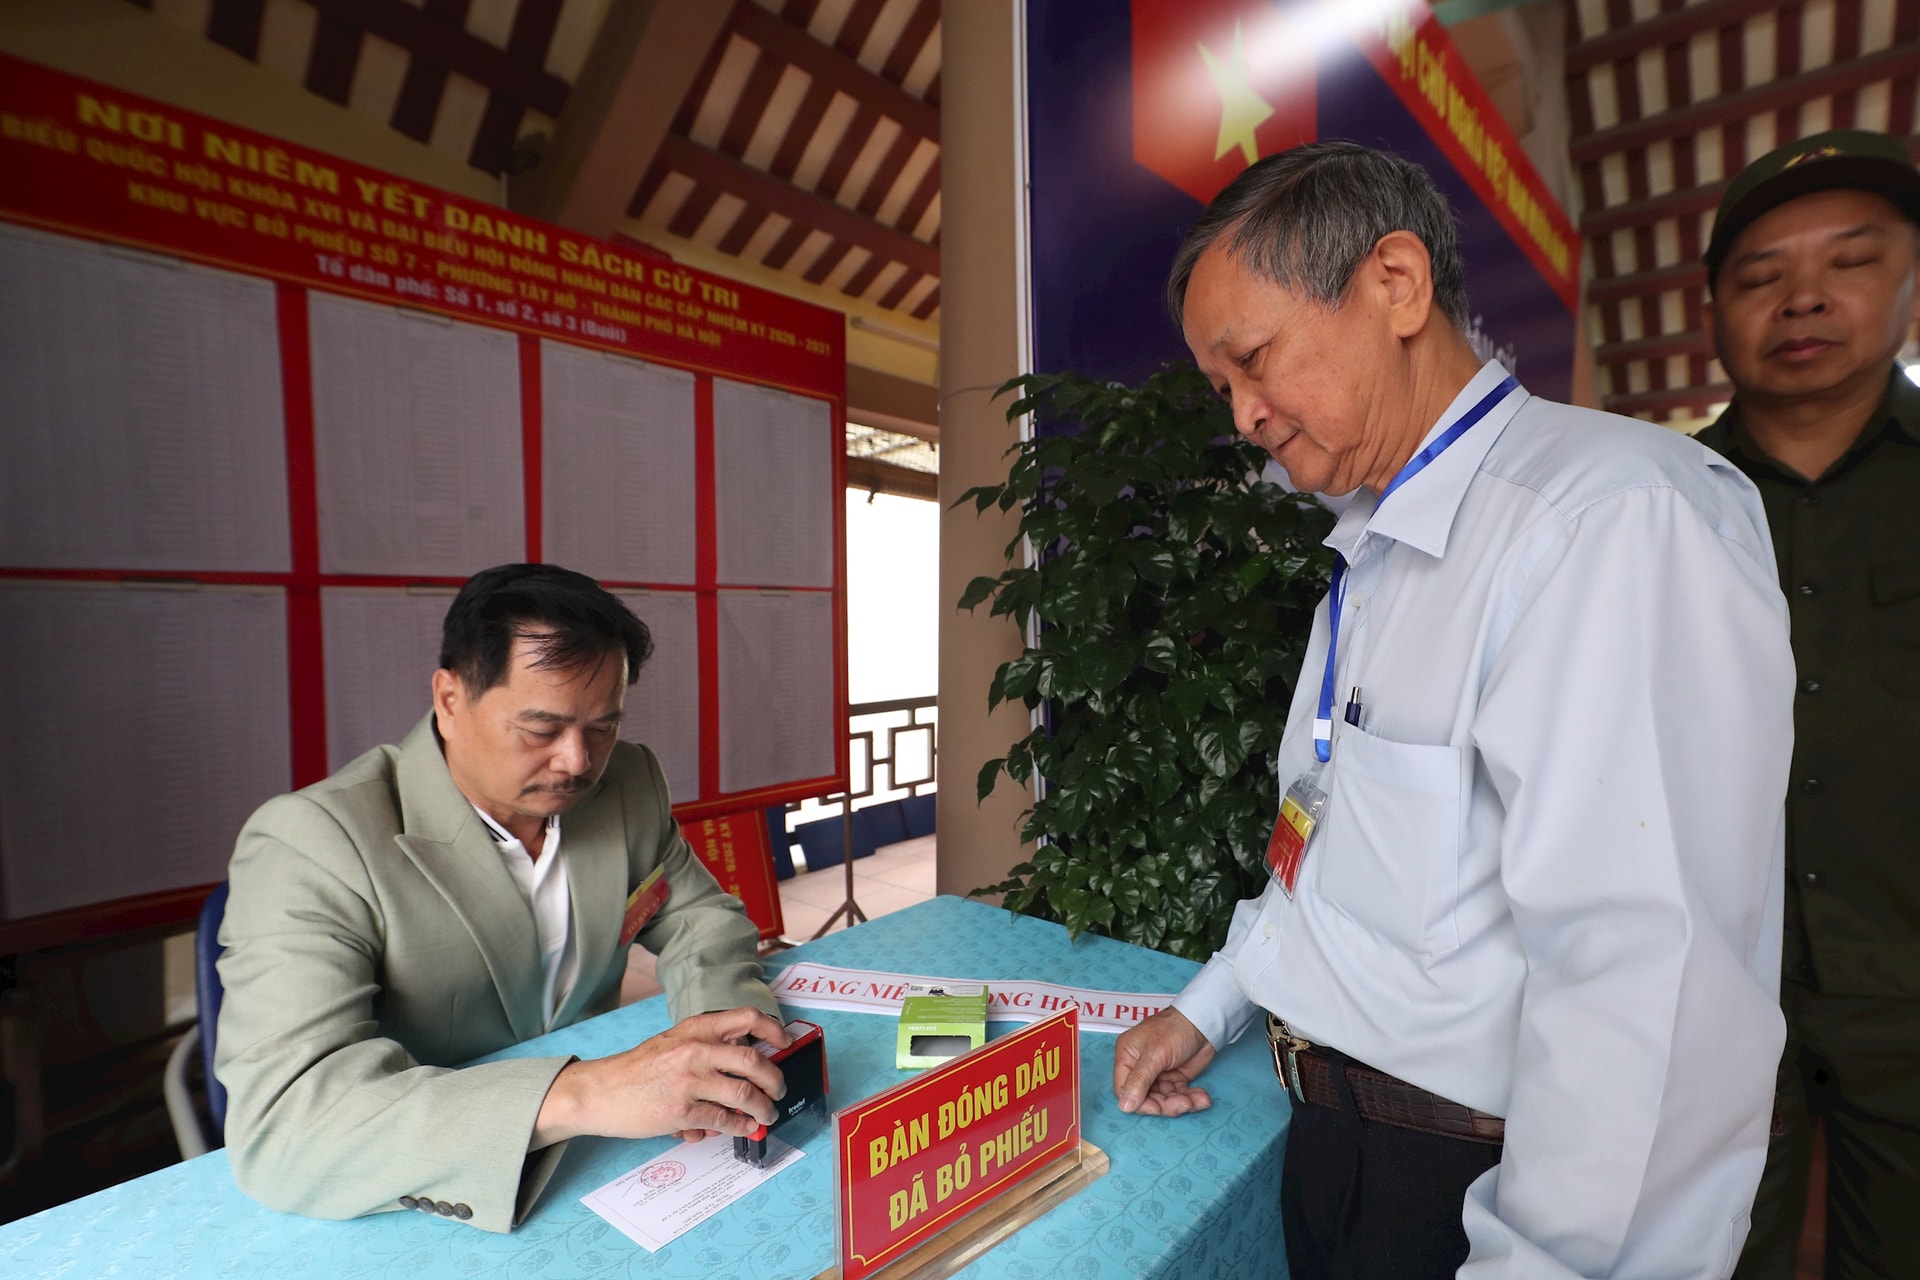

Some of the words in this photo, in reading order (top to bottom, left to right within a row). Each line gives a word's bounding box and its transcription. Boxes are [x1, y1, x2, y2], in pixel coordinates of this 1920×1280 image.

[76, 92, 186, 150] NƠI
[203, 130, 341, 196] NIÊM
[444, 204, 548, 254] DANH
[558, 238, 644, 282] SÁCH
[653, 263, 693, 296] CỬ
[700, 282, 740, 311] TRI
[302, 195, 344, 225] XVI
[346, 208, 379, 233] VÀ
[348, 260, 391, 290] dân
[566, 314, 578, 333] 3
[404, 250, 419, 272] 7
[786, 975, 861, 995] BĂNG
[862, 981, 910, 1001] NIÊ
[869, 1112, 930, 1178] BÀN
[938, 1073, 1009, 1141] ĐÓNG
[1016, 1041, 1060, 1099] DẤU
[889, 1171, 929, 1232] ĐÃ
[936, 1142, 972, 1203] BỎ
[980, 1105, 1048, 1178] PHIẾU
